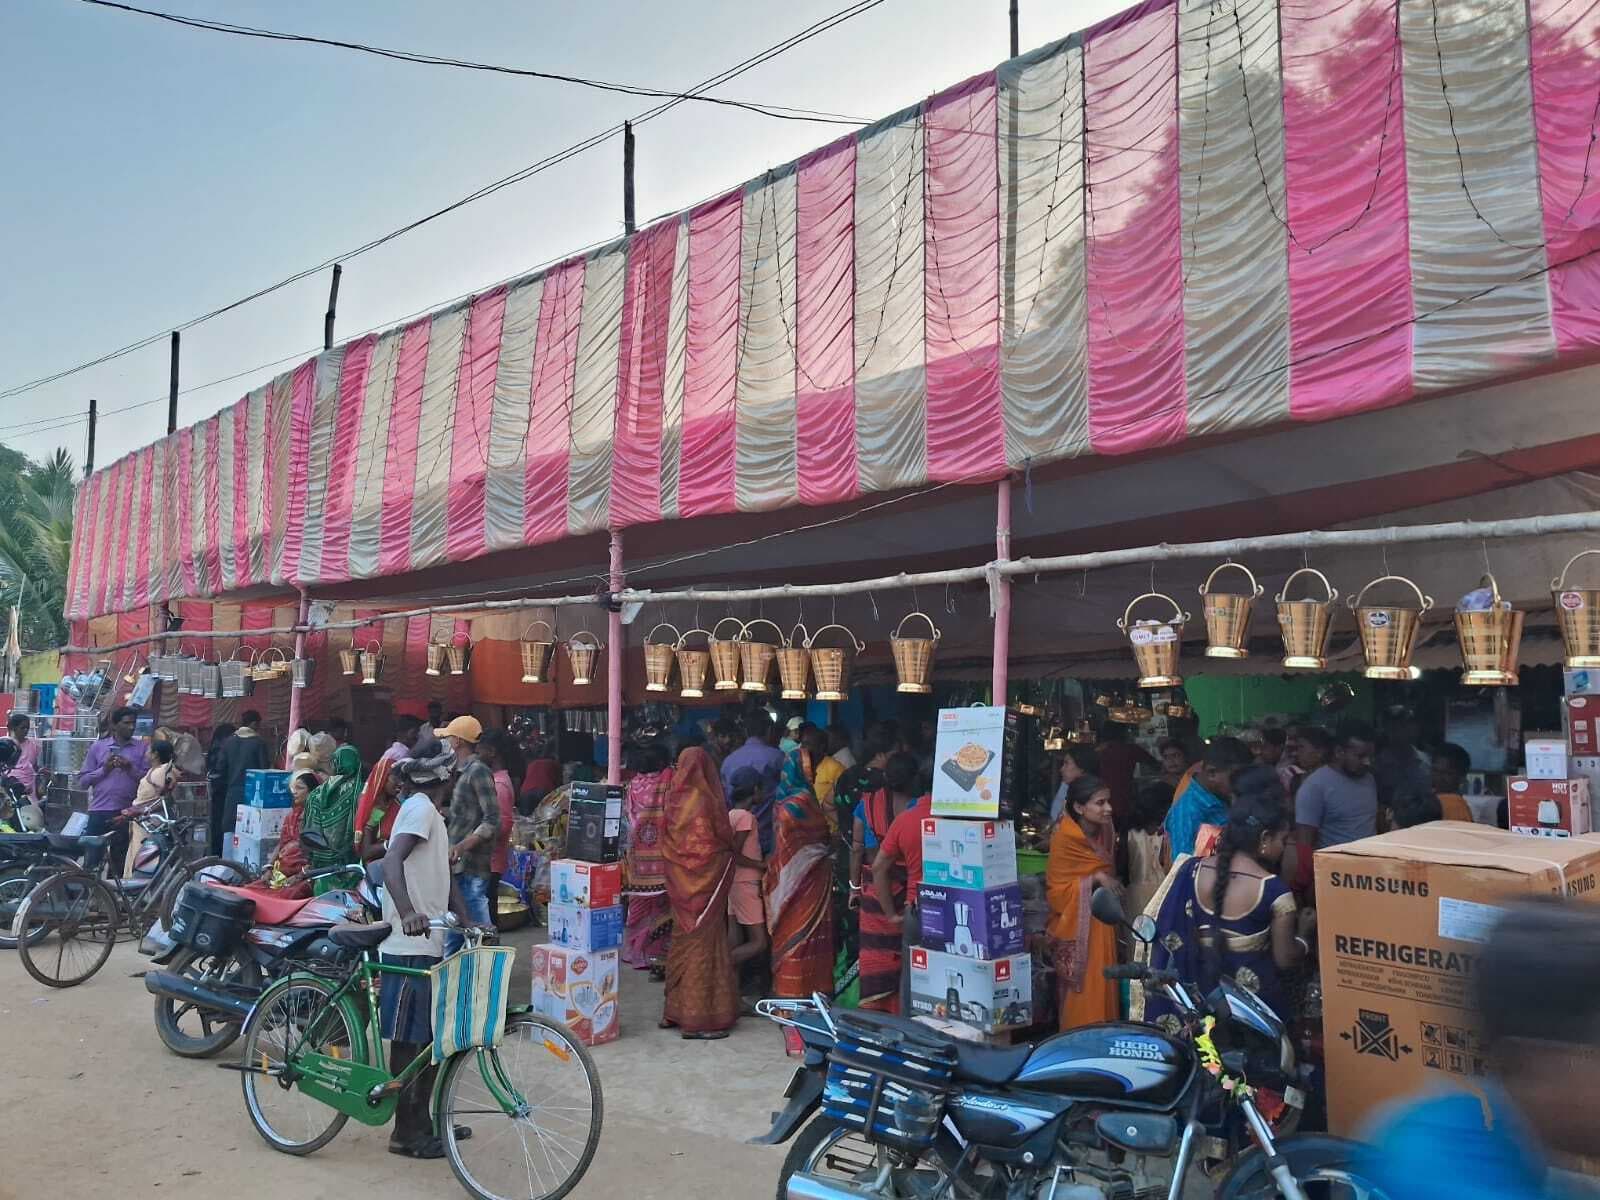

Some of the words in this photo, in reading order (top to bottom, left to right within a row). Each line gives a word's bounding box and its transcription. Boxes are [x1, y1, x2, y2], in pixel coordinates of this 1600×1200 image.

[1331, 872, 1429, 897] SAMSUNG
[1335, 934, 1478, 973] REFRIGERAT
[1109, 1047, 1165, 1061] HONDA
[1114, 1040, 1159, 1052] HERO
